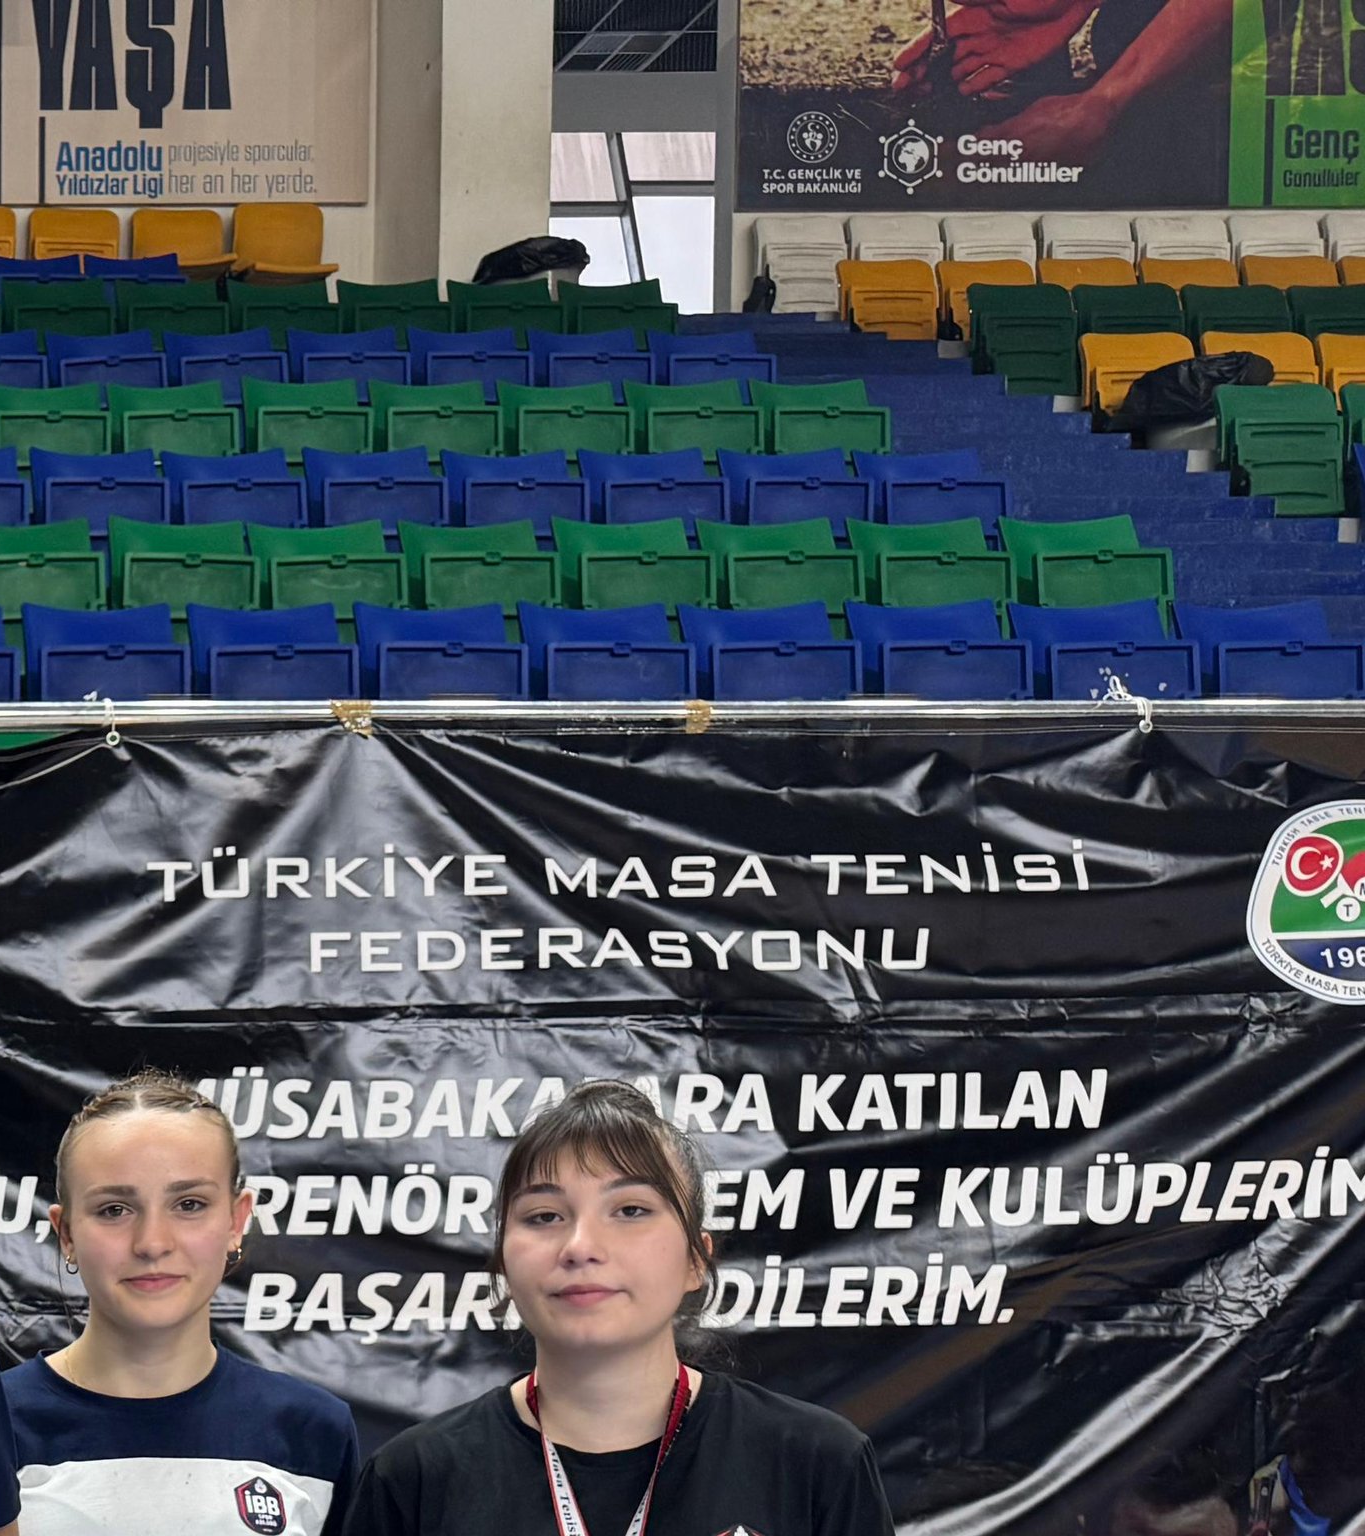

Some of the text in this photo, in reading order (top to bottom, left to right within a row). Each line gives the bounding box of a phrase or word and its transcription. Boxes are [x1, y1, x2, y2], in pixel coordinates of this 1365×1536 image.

[33, 0, 232, 128] YAŞA
[56, 140, 162, 172] Anadolu
[168, 142, 240, 167] projesiyle
[956, 135, 1023, 161] Genç
[1285, 124, 1360, 164] Genç
[56, 168, 318, 199] Yıldızlar Ligi her an her yerde.
[762, 166, 862, 182] T.C. GENÇLİK VE
[762, 181, 862, 194] SPOR BAKANLIĞI
[956, 162, 1084, 183] Gönüllüler
[146, 839, 1090, 902] TÜRKİYE MASA TENİSİ
[310, 927, 930, 973] FEDERASYONU
[798, 1068, 1108, 1132] KATILAN
[828, 1168, 921, 1231] VE
[699, 1252, 1016, 1328] DİLERİM.
